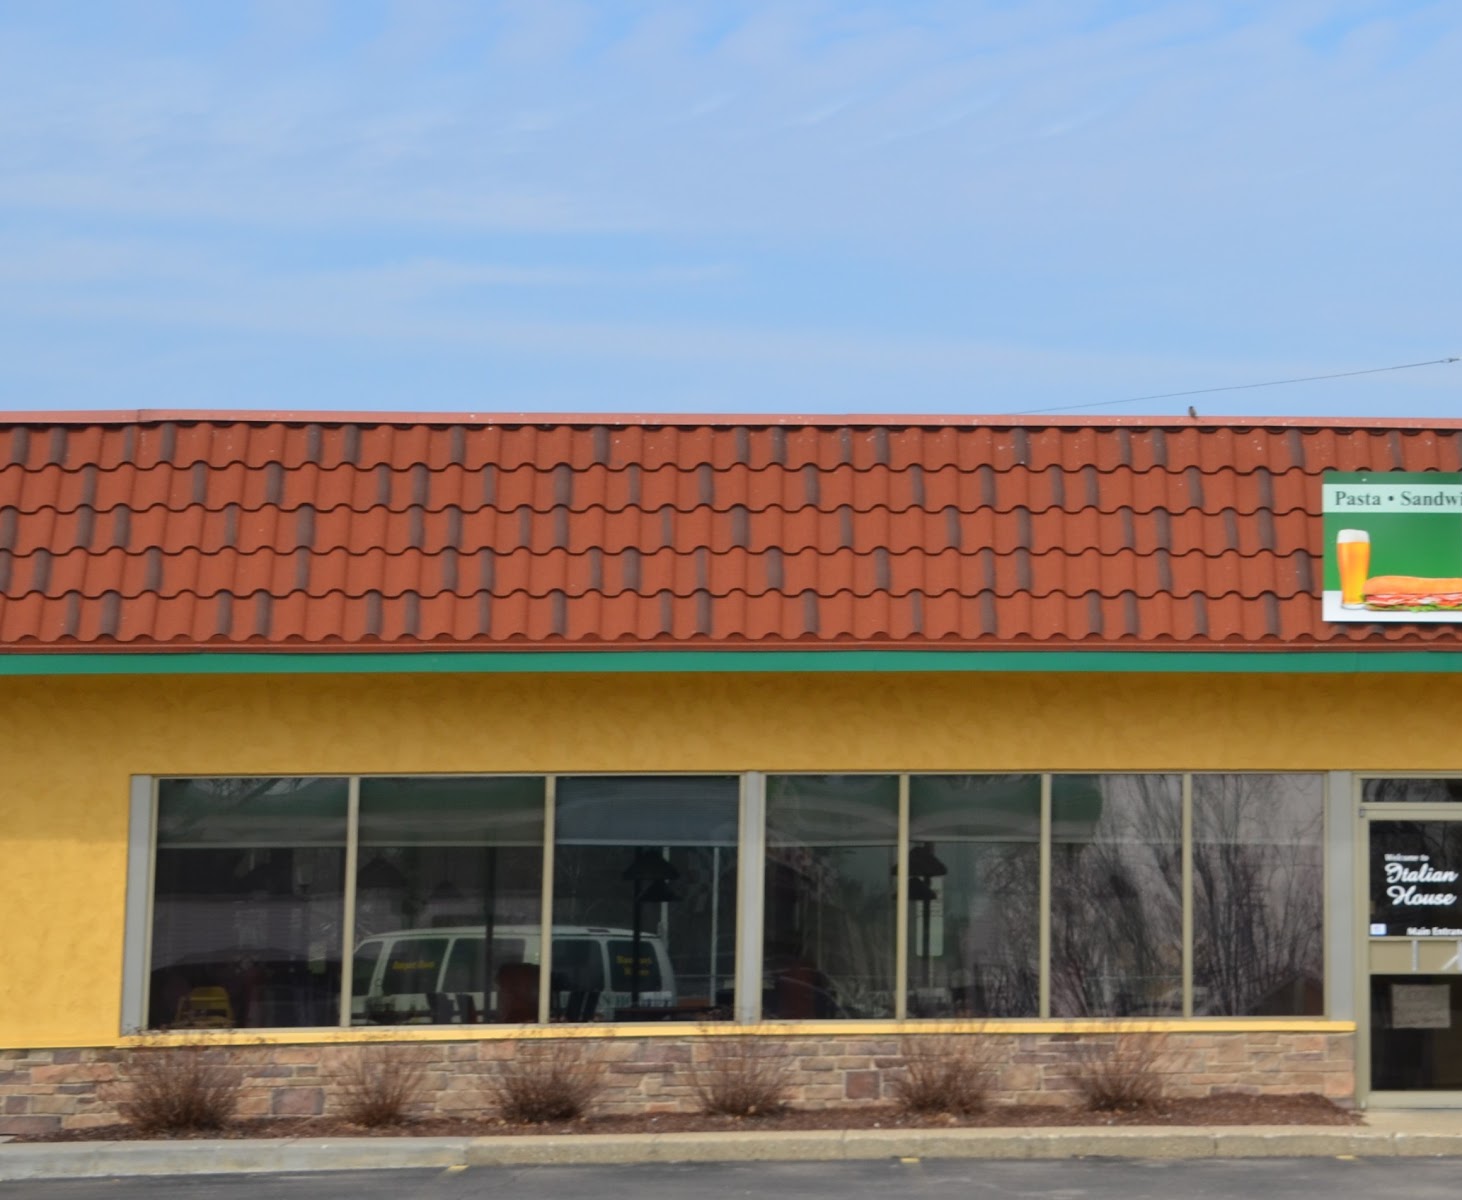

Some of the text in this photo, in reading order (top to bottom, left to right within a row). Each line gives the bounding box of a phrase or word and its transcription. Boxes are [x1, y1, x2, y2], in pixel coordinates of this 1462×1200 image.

[1335, 491, 1381, 506] Pasta
[1384, 853, 1419, 862] Welcome
[1384, 862, 1459, 884] Italian
[1386, 885, 1457, 906] House
[1406, 926, 1431, 936] Main
